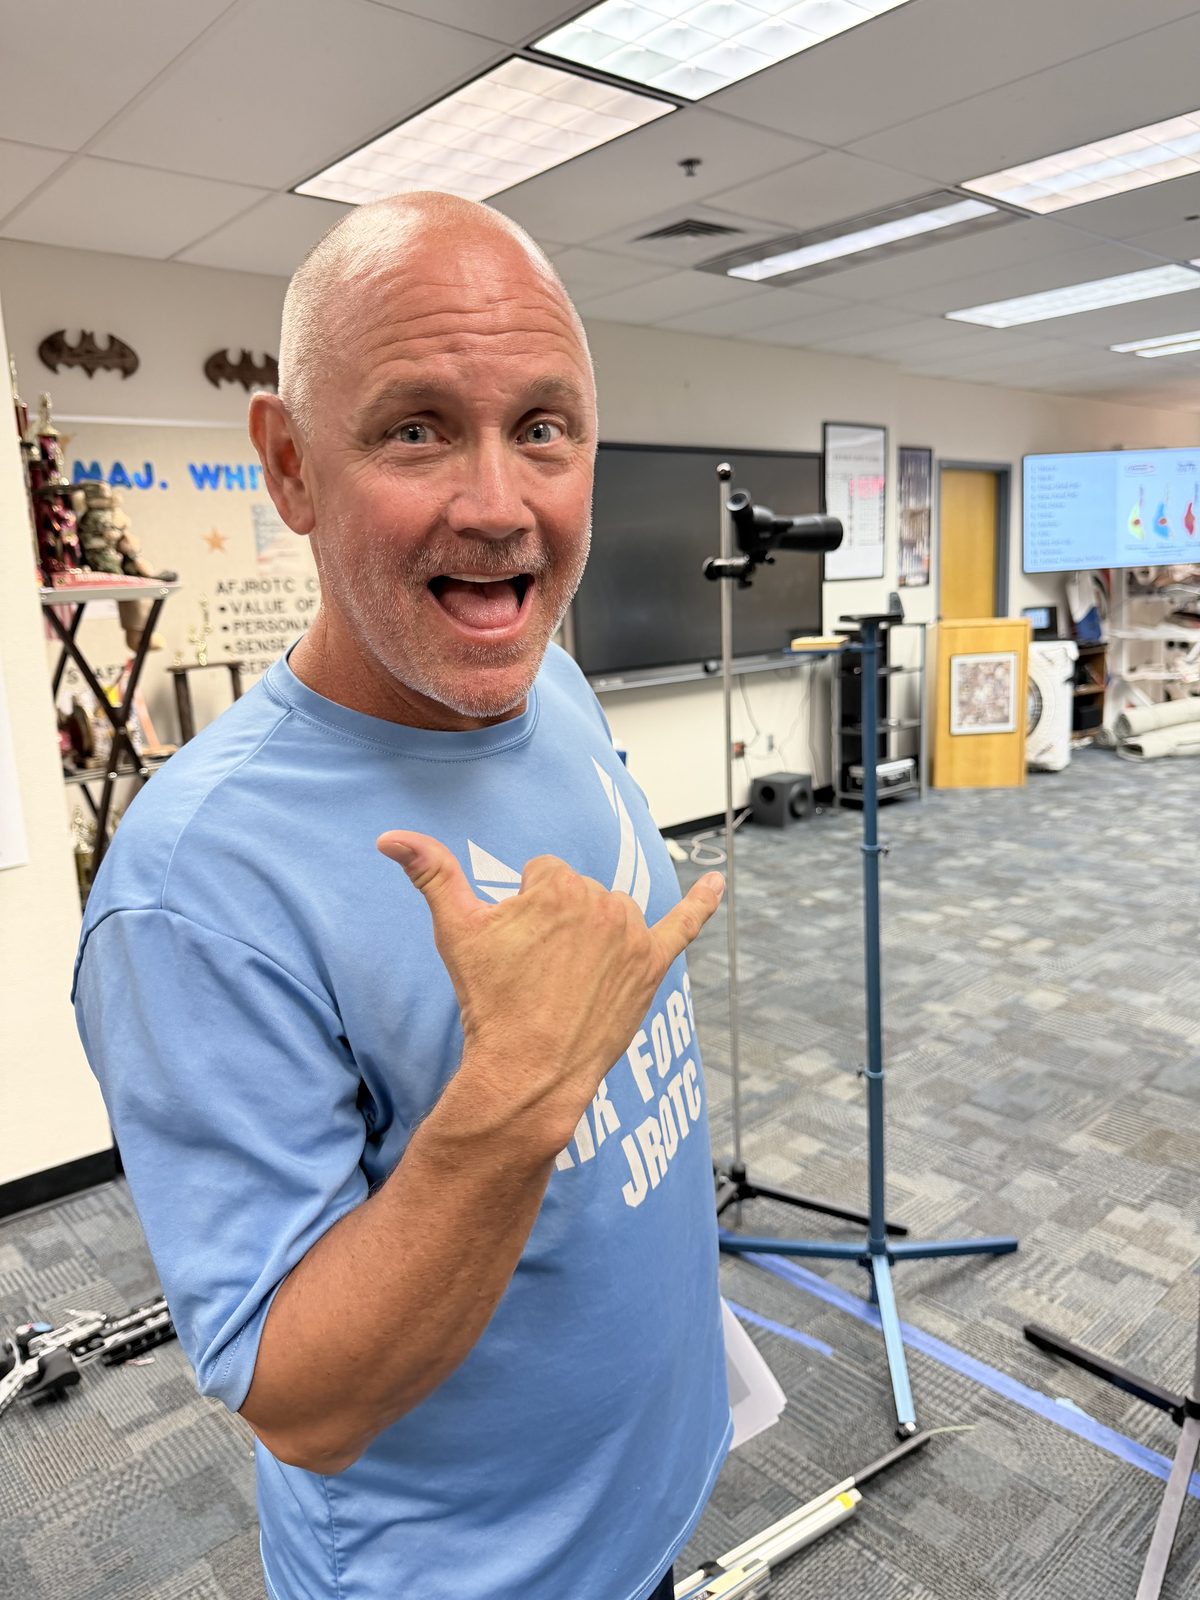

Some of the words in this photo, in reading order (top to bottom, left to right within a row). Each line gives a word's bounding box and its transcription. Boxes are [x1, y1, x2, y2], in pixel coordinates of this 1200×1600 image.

[72, 460, 168, 490] MAJ.
[187, 463, 263, 490] WHI
[216, 579, 295, 594] AFJROTC
[229, 600, 286, 615] VALUE
[621, 1058, 702, 1208] JROTC
